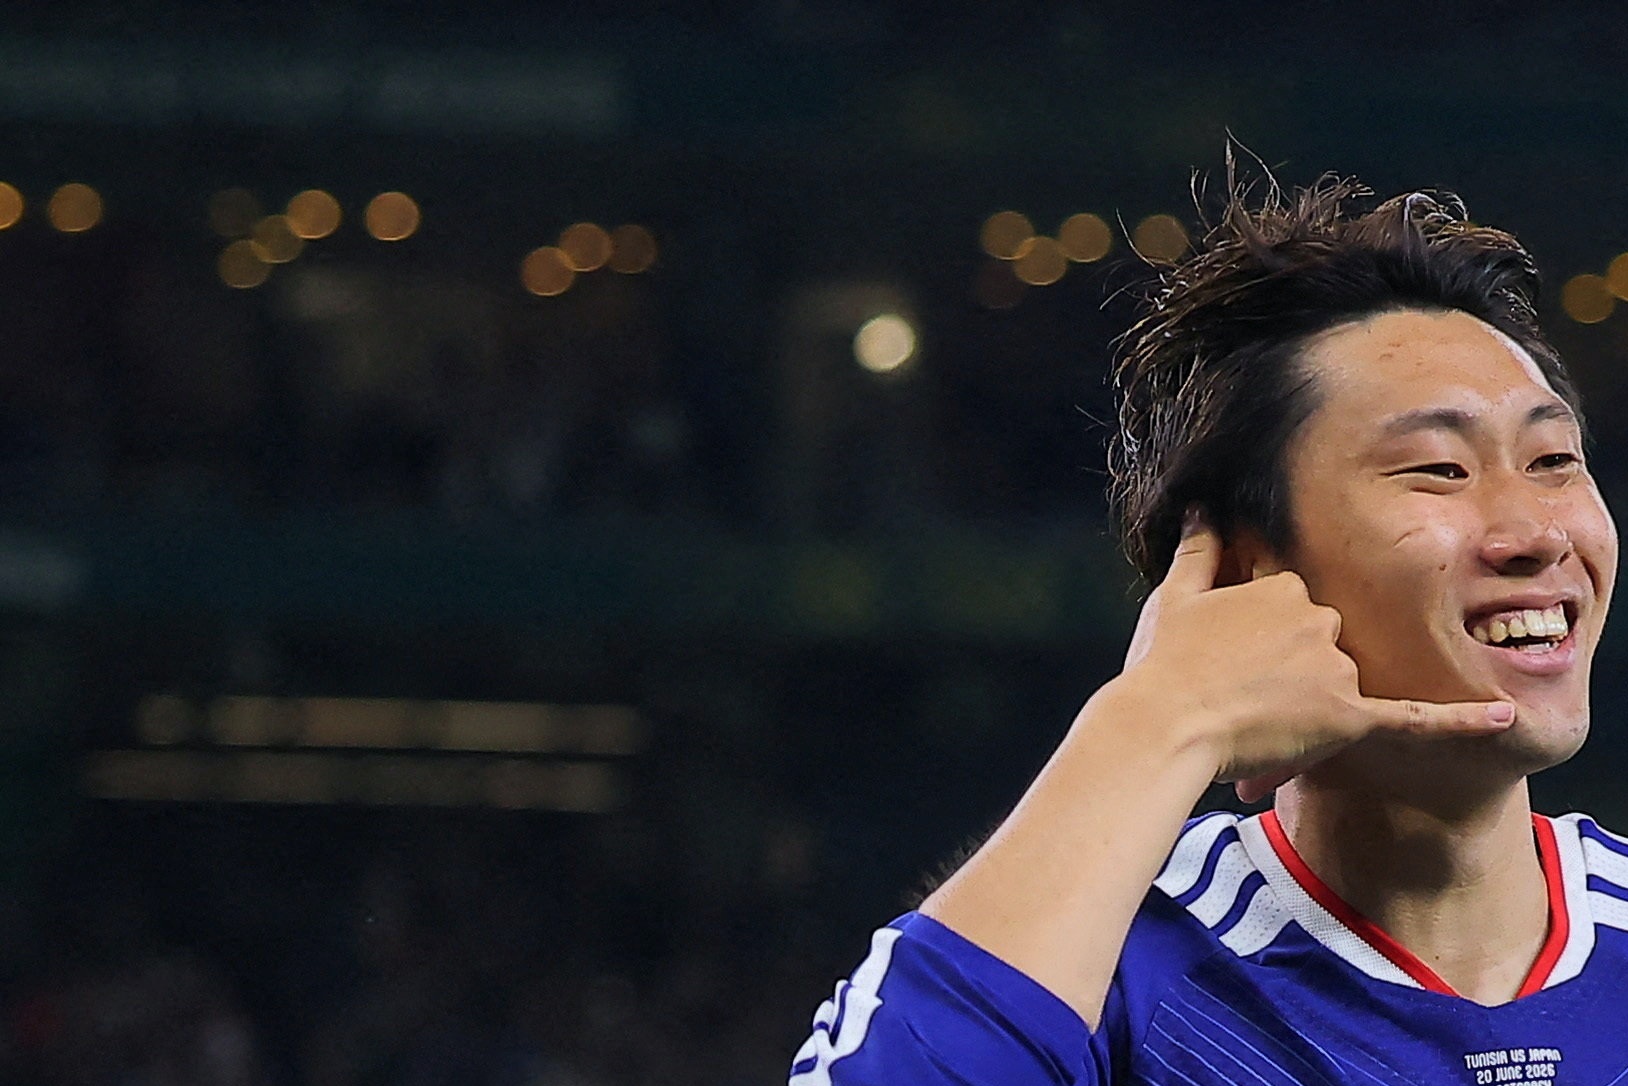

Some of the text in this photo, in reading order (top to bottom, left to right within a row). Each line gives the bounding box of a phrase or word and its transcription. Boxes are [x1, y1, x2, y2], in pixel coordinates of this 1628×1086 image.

[1464, 1050, 1508, 1069] TUNISIA
[1529, 1048, 1562, 1062] JAPAN
[1476, 1063, 1556, 1084] 20 JUNE 2026
